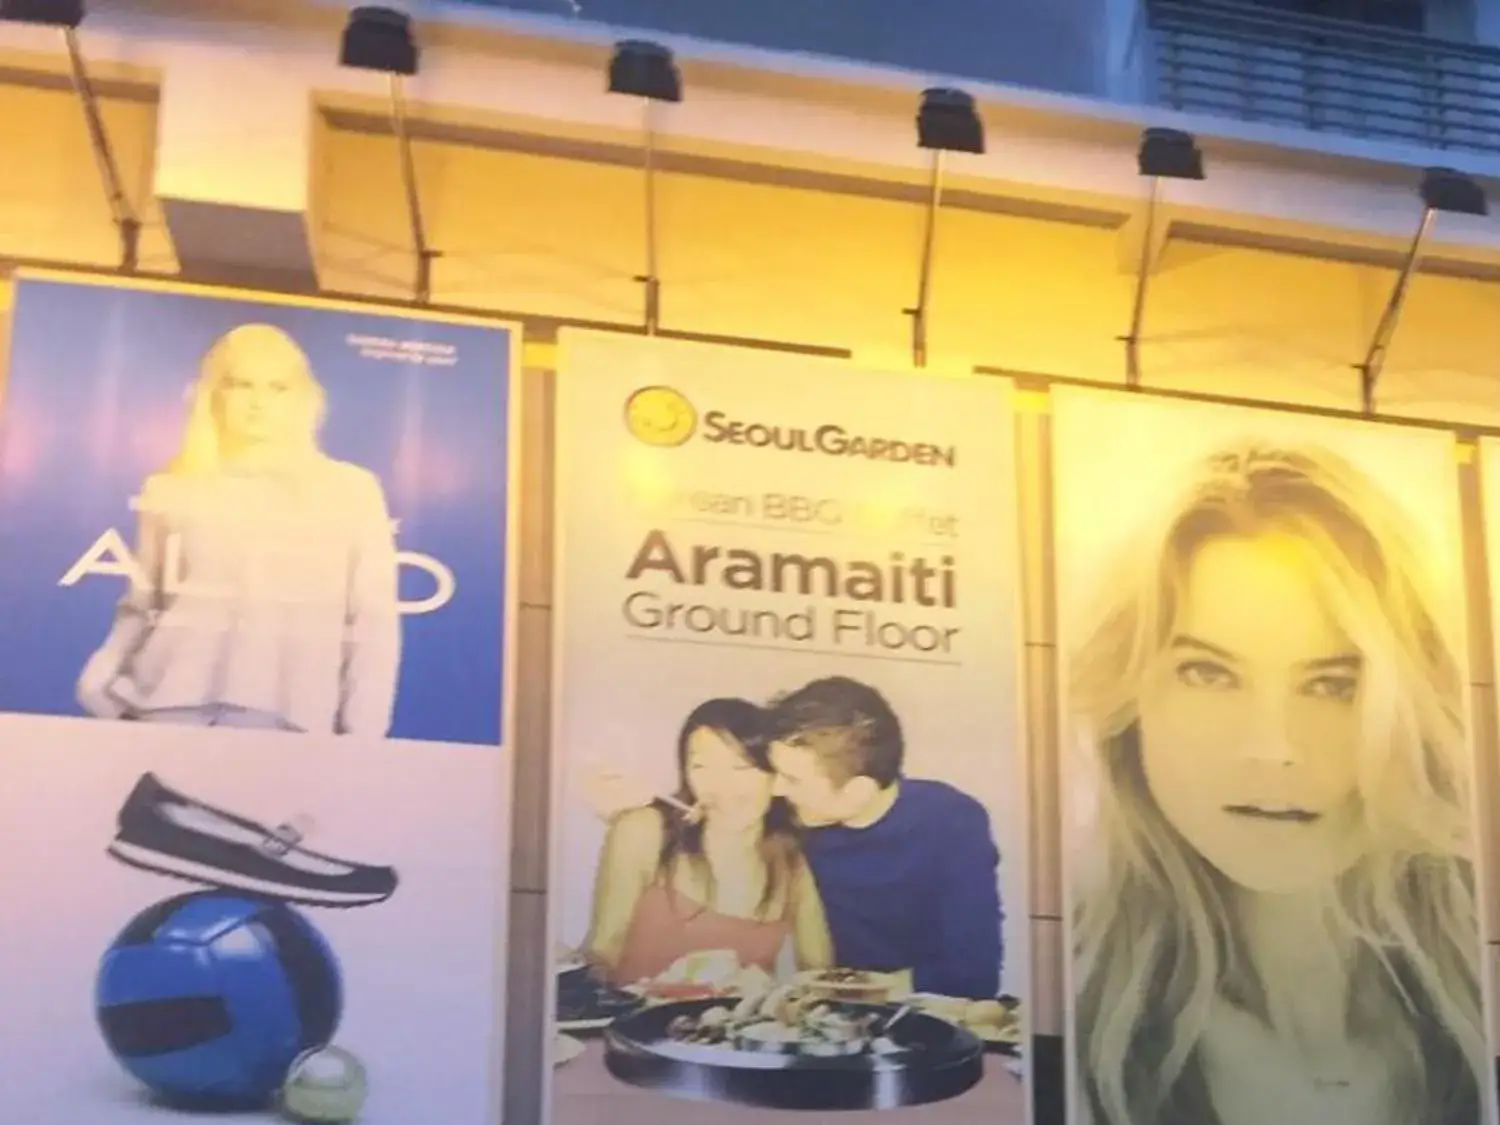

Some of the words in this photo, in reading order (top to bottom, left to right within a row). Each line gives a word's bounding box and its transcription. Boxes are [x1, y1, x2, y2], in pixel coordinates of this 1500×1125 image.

[625, 528, 957, 609] Aramaiti
[623, 590, 814, 642] Ground
[831, 607, 963, 654] Floor
